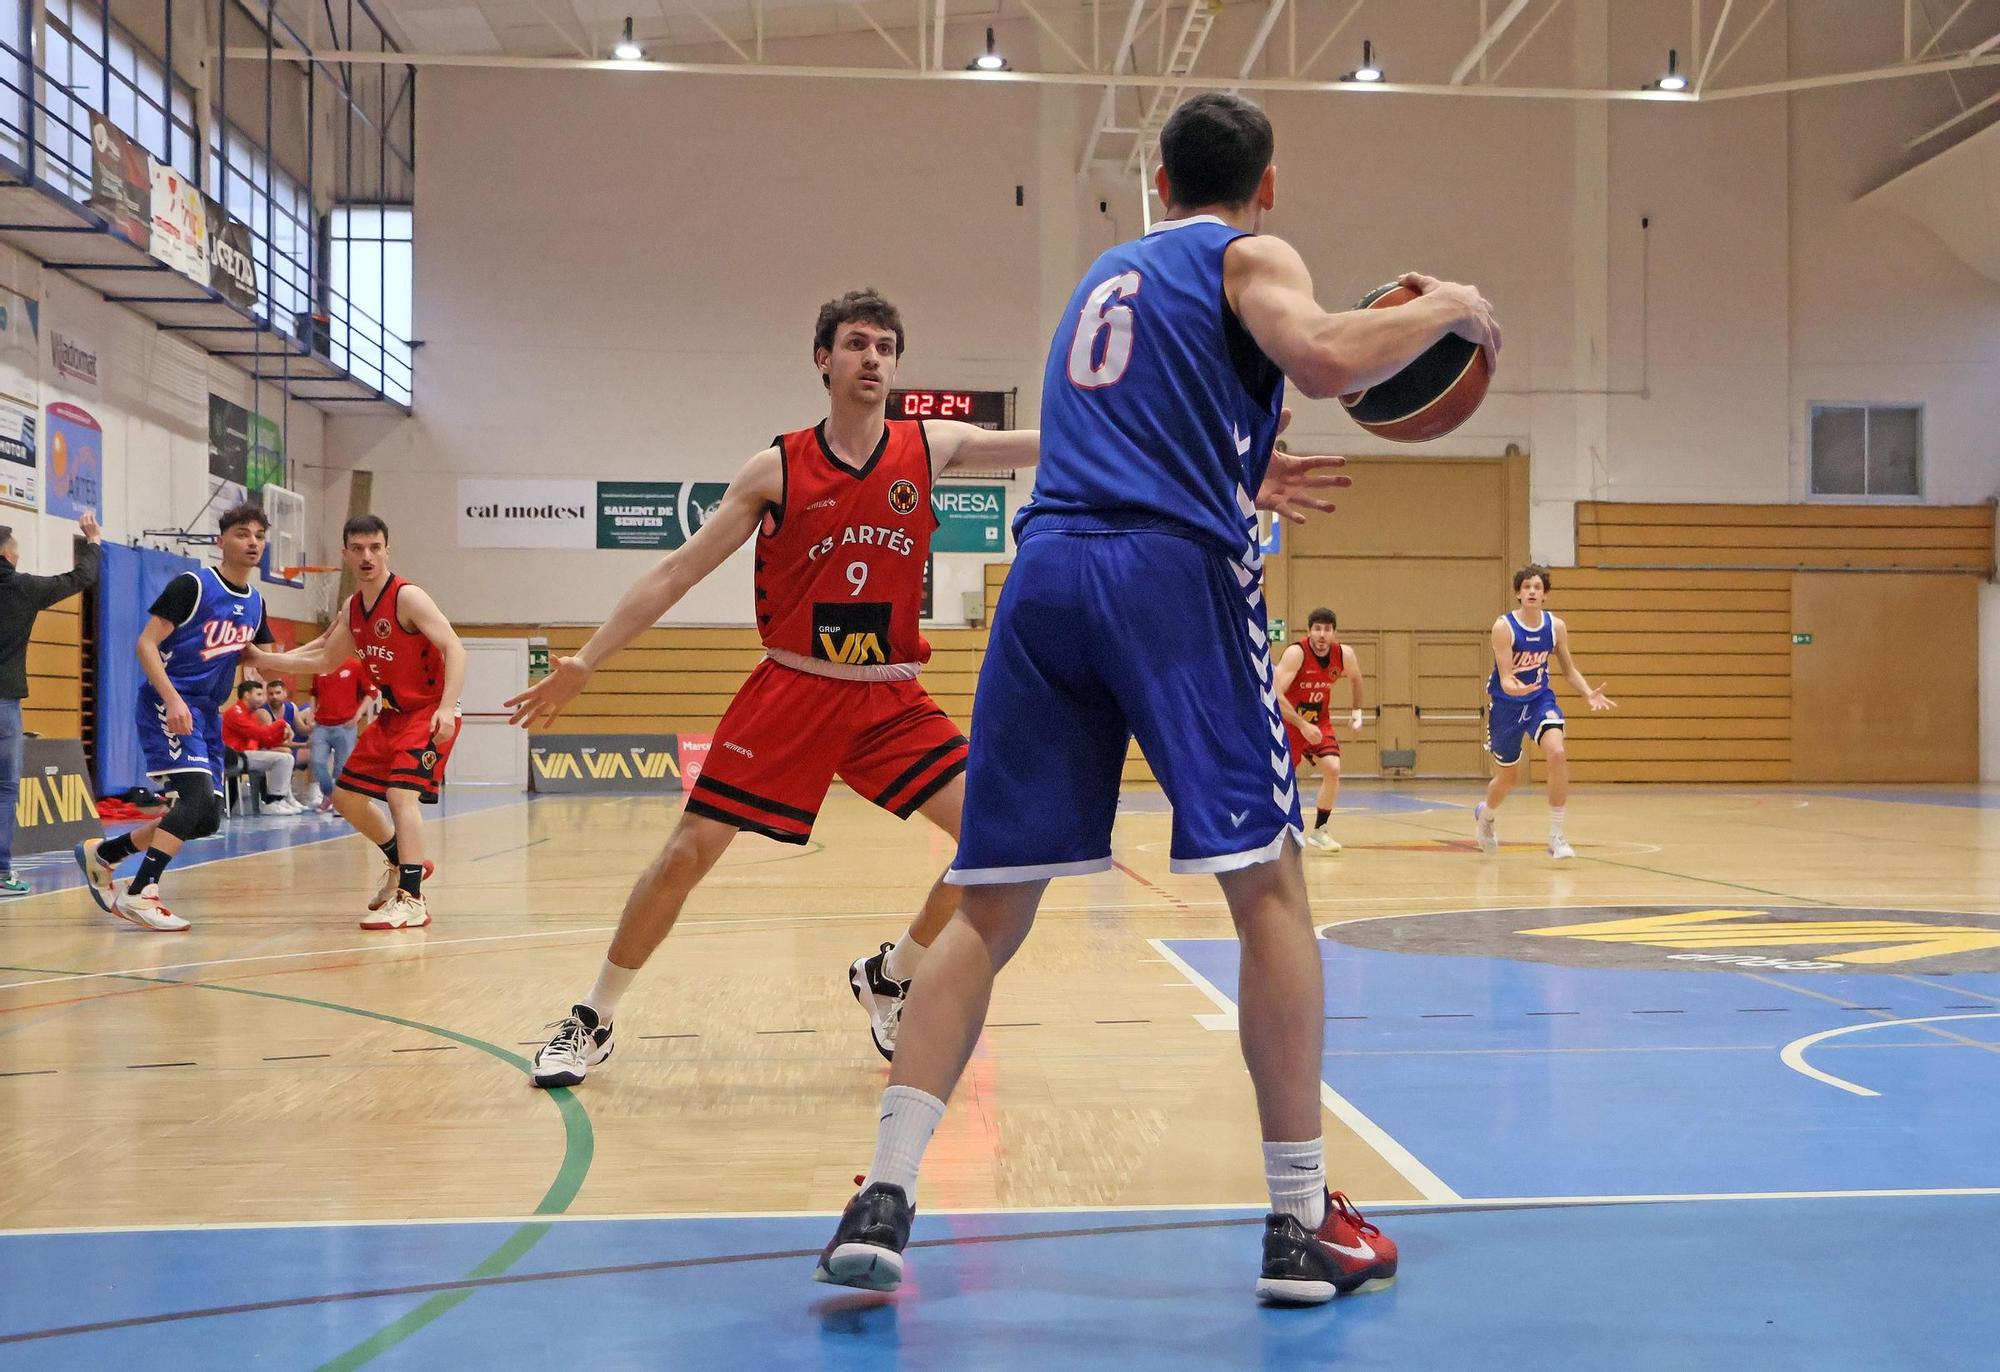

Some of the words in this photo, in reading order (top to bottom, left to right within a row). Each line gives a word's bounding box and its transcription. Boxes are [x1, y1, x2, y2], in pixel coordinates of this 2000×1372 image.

[1065, 270, 1142, 391] 6
[466, 504, 498, 518] cal
[505, 504, 585, 519] modest
[603, 505, 654, 516] SALLENT
[657, 506, 674, 516] DE
[614, 517, 663, 527] SERVEIS
[808, 536, 834, 561] CB
[841, 525, 914, 556] ARTÉS
[846, 561, 868, 596] 9
[366, 645, 395, 662] RTÉS
[819, 633, 885, 665] VIA
[1309, 692, 1324, 703] 10
[532, 753, 583, 779] VIA
[581, 753, 633, 779] VIA
[631, 753, 682, 778] VIA
[46, 773, 100, 823] VIA
[1666, 953, 1844, 970] GRUP
